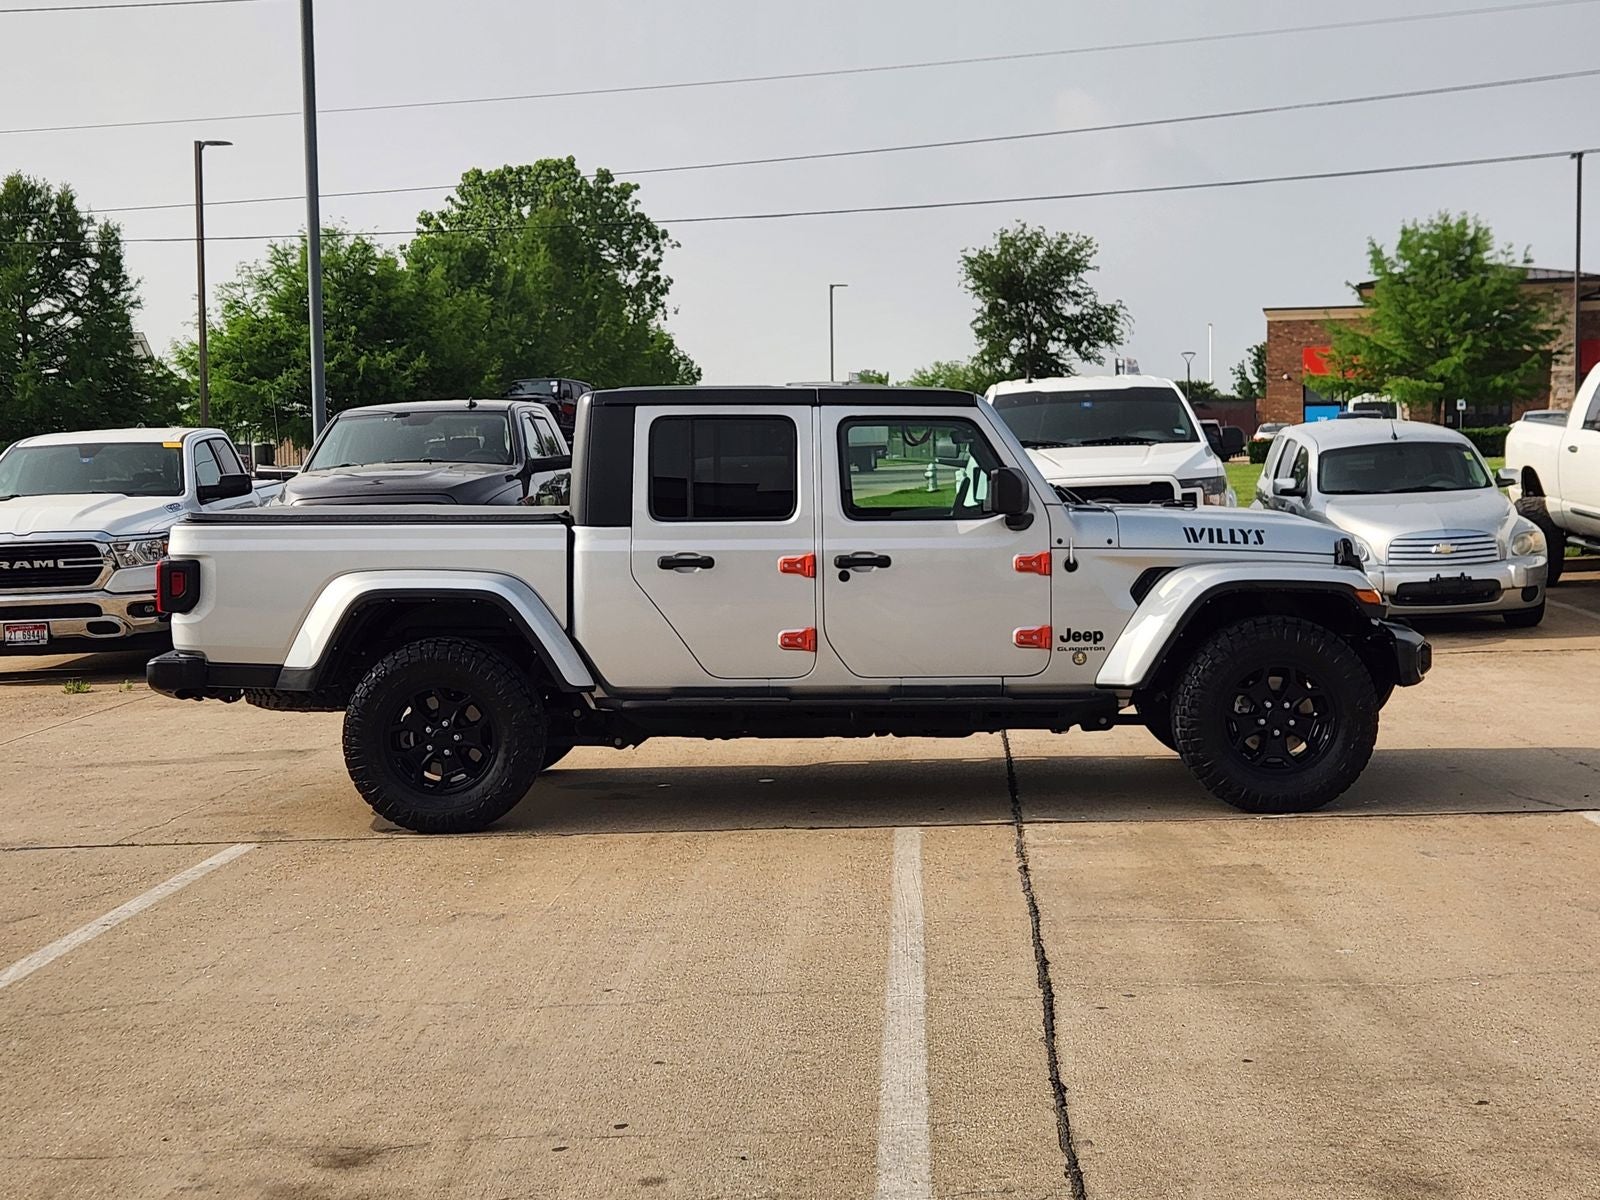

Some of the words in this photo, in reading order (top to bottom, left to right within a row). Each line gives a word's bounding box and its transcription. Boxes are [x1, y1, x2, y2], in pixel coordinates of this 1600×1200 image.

[1182, 526, 1265, 546] WILLYS
[0, 559, 55, 569] RAM
[1059, 627, 1104, 645] Jeep
